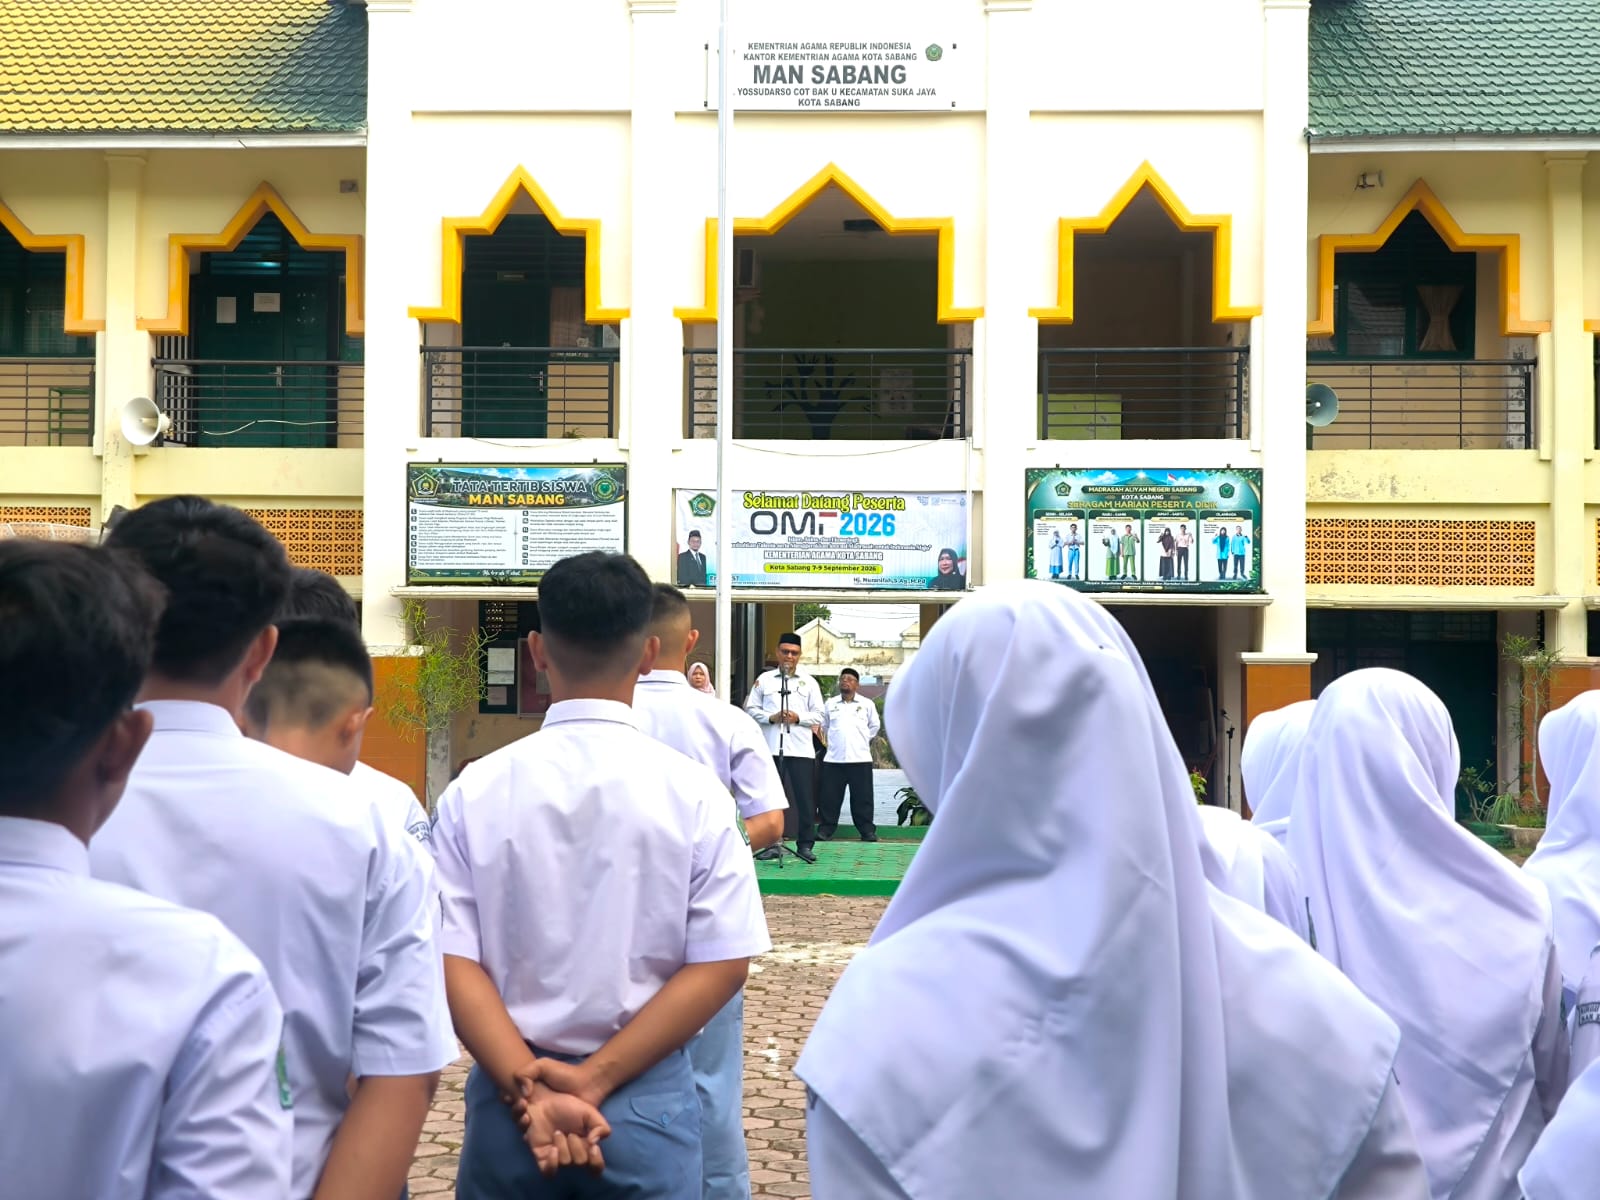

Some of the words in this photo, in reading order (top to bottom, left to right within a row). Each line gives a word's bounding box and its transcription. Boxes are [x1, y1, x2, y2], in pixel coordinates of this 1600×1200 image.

[748, 42, 798, 50] KEMENTRIAN
[800, 42, 827, 50] AGAMA
[829, 42, 867, 50] REPUBLIK
[869, 42, 911, 50] INDONESIA
[743, 53, 776, 61] KANTOR
[778, 53, 829, 61] KEMENTRIAN
[831, 53, 859, 61] AGAMA
[861, 53, 882, 61] KOTA
[884, 53, 917, 61] SABANG
[753, 64, 803, 84] MAN
[811, 64, 906, 85] SABANG
[737, 87, 791, 96] YOSSUDARSO
[793, 87, 810, 96] COT
[812, 87, 828, 96] BAK
[831, 87, 837, 96] U
[839, 87, 889, 96] KECAMATAN
[891, 87, 914, 96] SUKA
[916, 87, 936, 96] JAYA
[798, 98, 821, 106] KOTA
[824, 98, 860, 107] SABANG
[453, 480, 488, 493] TATA
[491, 480, 539, 493] TERTIB
[542, 480, 587, 493] SISWA
[469, 493, 504, 505] MAN
[507, 493, 565, 505] SABANG
[743, 491, 799, 509] Selamat
[801, 492, 850, 513] Datang
[852, 492, 906, 510] Peserta
[1067, 500, 1112, 508] SERAGAM
[1114, 500, 1149, 508] HARIAN
[1151, 500, 1193, 509] PESERTA
[839, 512, 896, 536] 2026
[837, 551, 855, 560] KOTA
